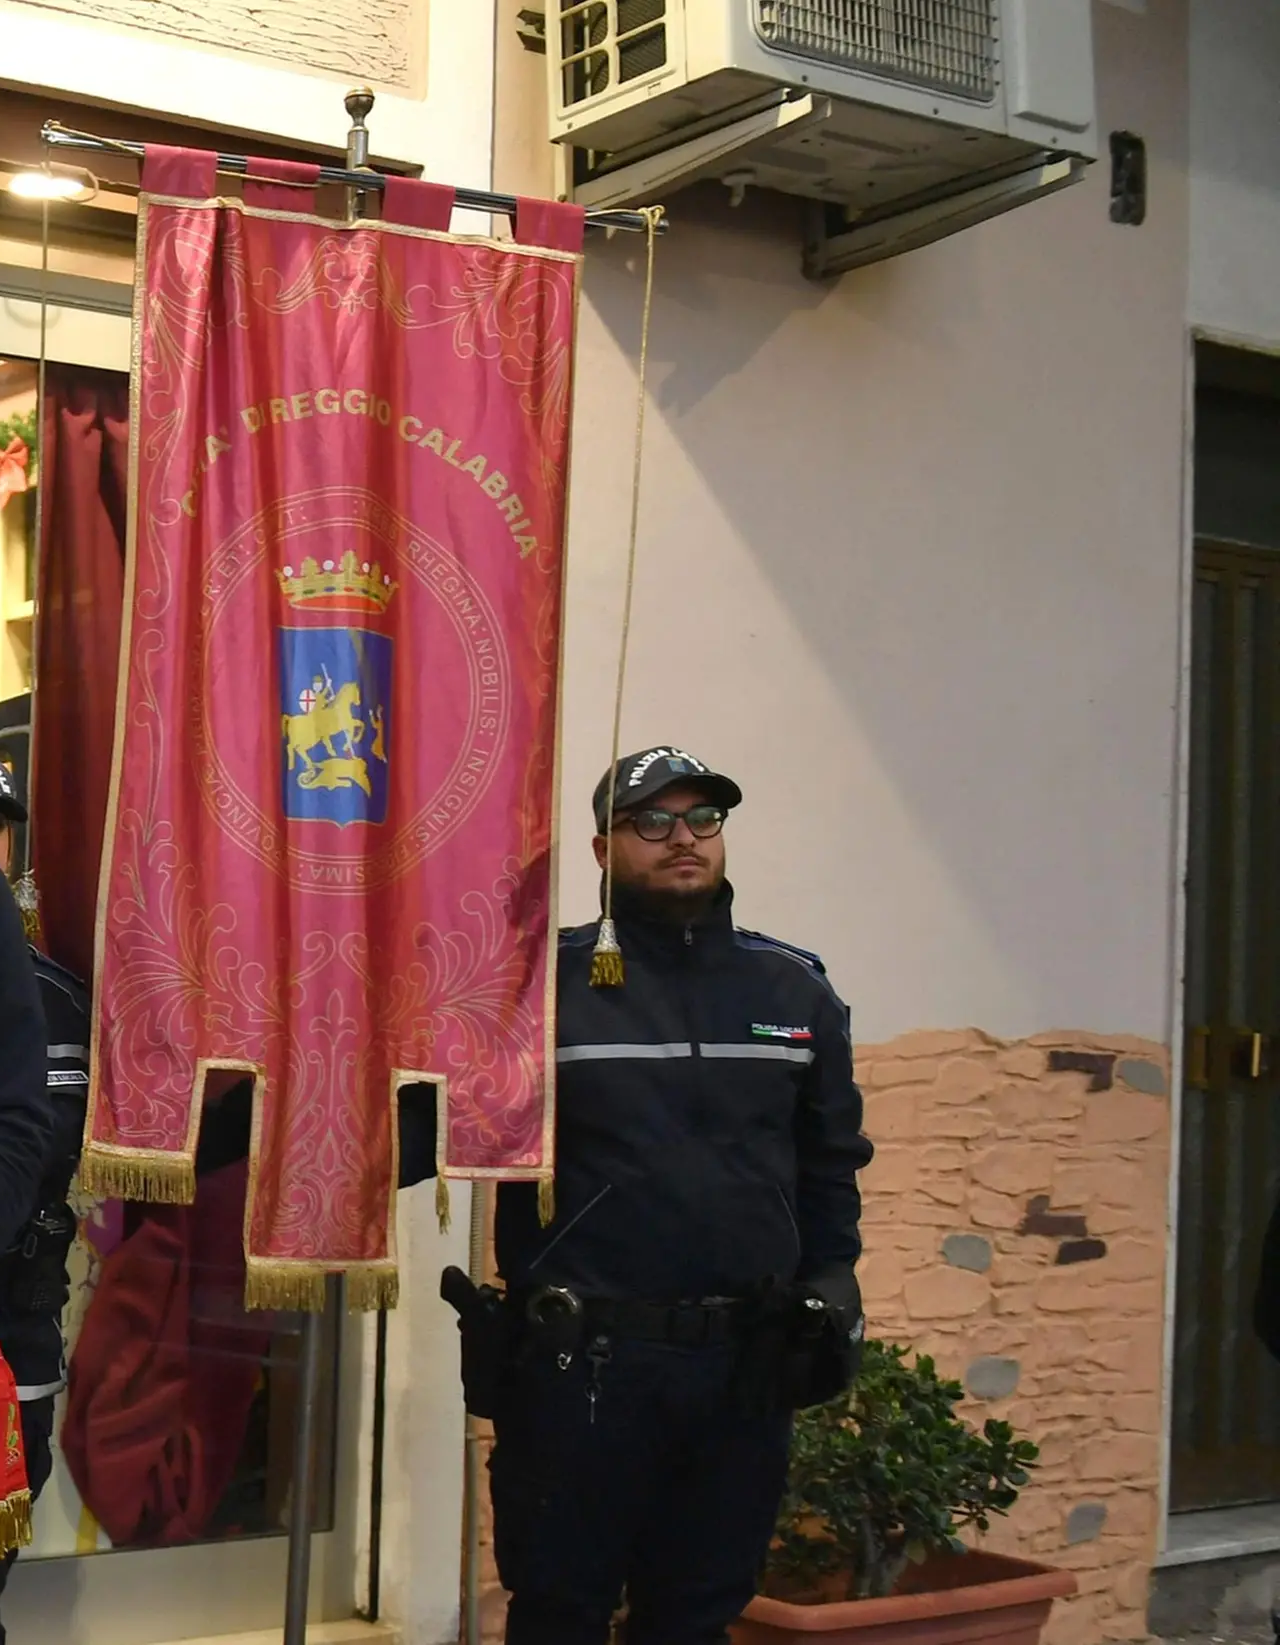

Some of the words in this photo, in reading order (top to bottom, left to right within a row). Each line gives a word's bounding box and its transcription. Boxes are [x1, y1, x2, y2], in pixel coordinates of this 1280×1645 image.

[269, 388, 391, 427] REGGIO
[398, 415, 538, 560] CALABRIA
[629, 749, 671, 786] POLIZIA
